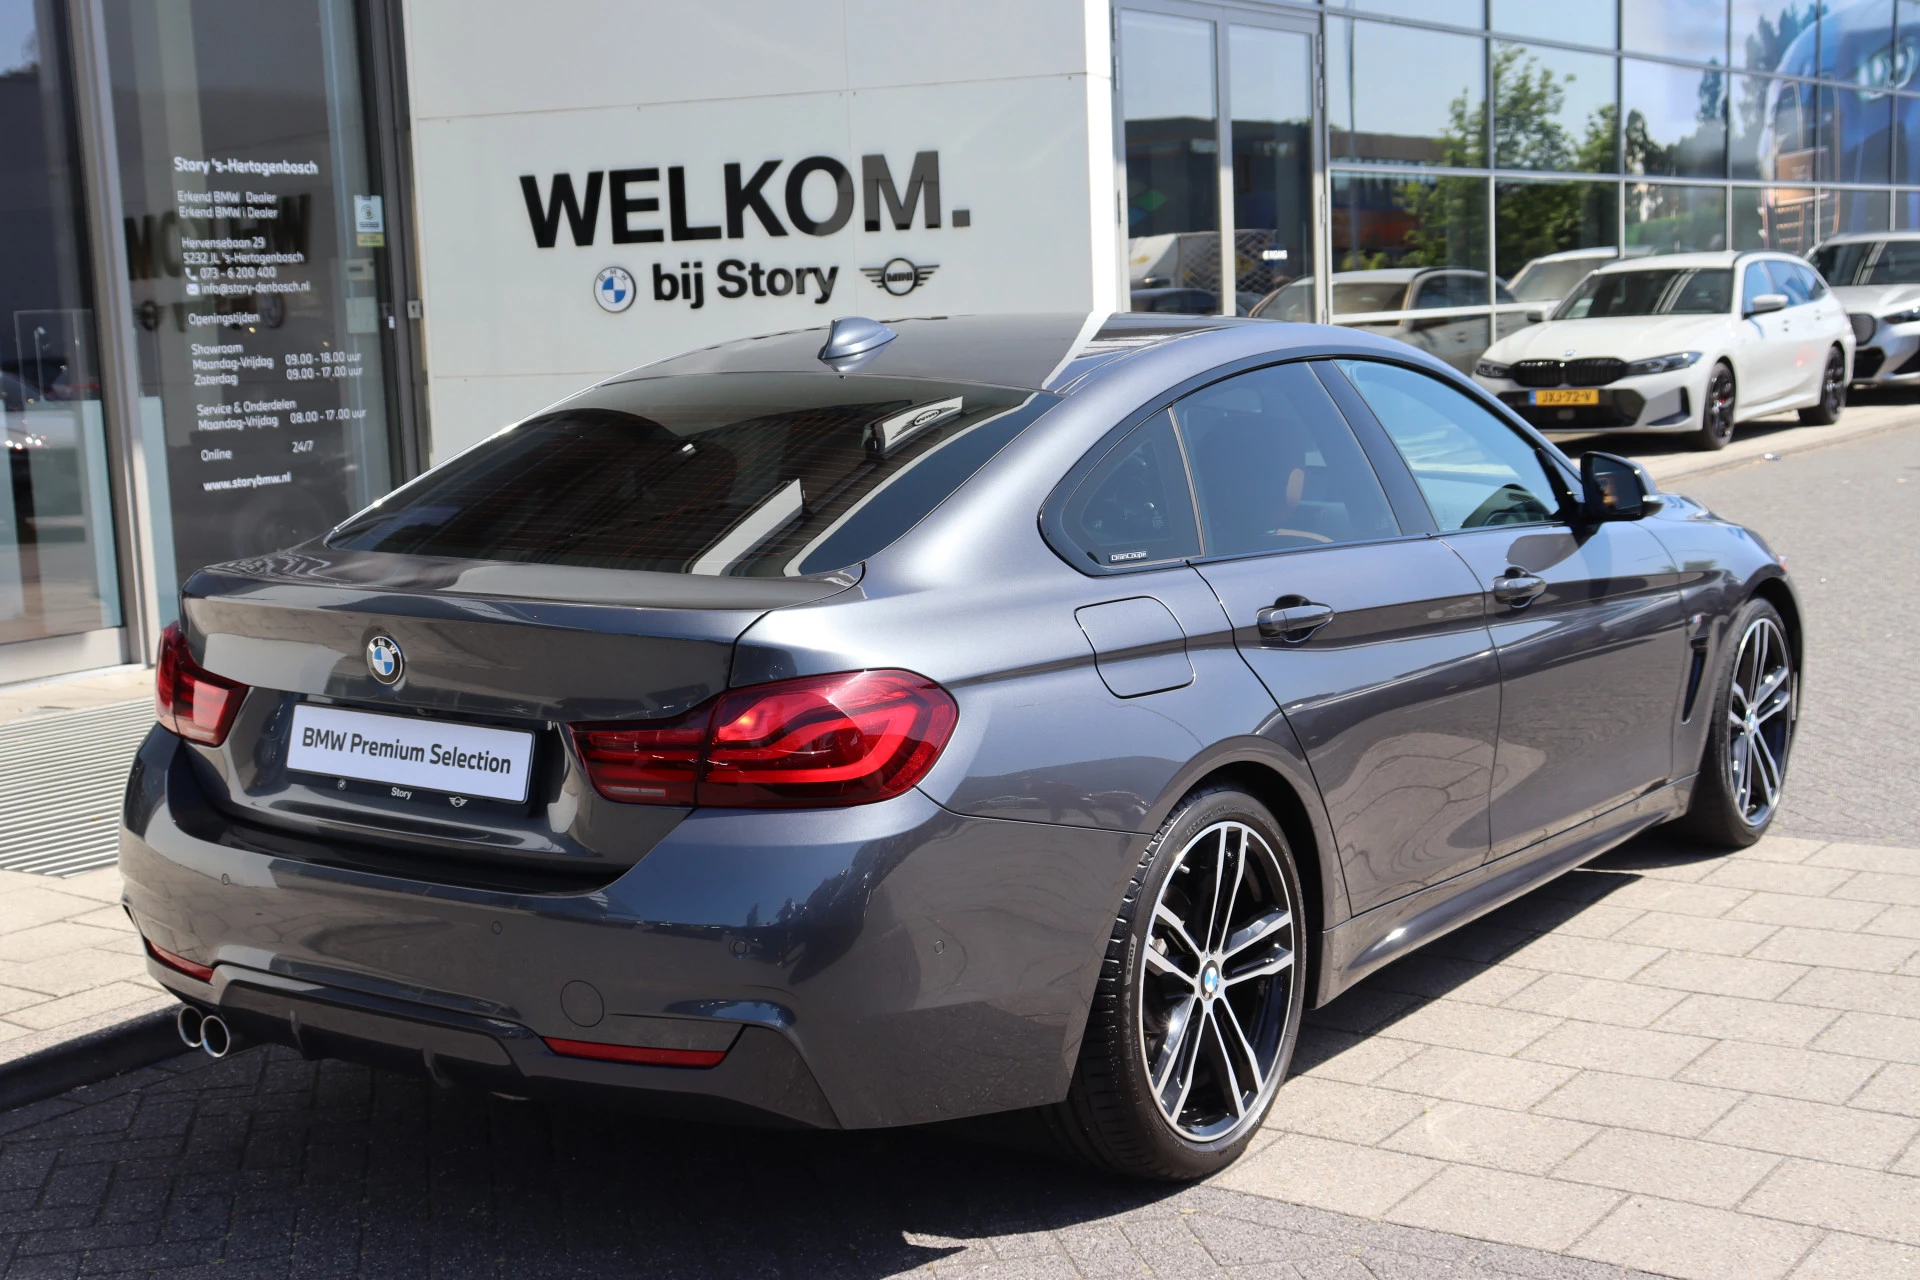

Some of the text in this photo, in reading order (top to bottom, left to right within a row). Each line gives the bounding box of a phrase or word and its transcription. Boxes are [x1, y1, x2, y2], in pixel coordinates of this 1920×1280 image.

[173, 156, 319, 177] Story 's-Hertogenbosch
[177, 190, 278, 204] Erkend BMW Dealer
[519, 150, 971, 249] WELKOM.
[178, 205, 278, 219] Erkend BMW i Dealer
[181, 236, 266, 249] Hervensebaan 29
[183, 251, 304, 265] 5232 JL 's-Hertogenbosch
[200, 266, 219, 279] 073
[227, 267, 235, 279] 6
[235, 266, 256, 279] 200
[257, 266, 277, 278] 400
[886, 271, 914, 282] MINI
[200, 280, 311, 295] info@story-denbosch.nl
[652, 258, 839, 310] bij Story
[188, 312, 261, 326] Openingstijden
[191, 343, 243, 356] Showroom
[192, 356, 274, 371] Maandag-Vrijdag
[285, 353, 313, 366] 09.00
[320, 351, 345, 363] 18.00
[346, 352, 362, 362] uur
[194, 374, 239, 387] Zaterdag
[286, 367, 314, 380] 09.00
[321, 365, 347, 378] 17.00
[348, 366, 363, 376] uur
[1542, 391, 1592, 402] JXJ-72-V
[196, 399, 297, 416] Service & Onderdelen
[198, 415, 279, 431] Maandag-Vrijdag
[290, 411, 318, 424] 08.00
[324, 409, 350, 421] 17.00
[351, 409, 367, 419] uur
[200, 440, 314, 461] Online 24/7
[203, 471, 292, 491] www.storybmw.nl
[368, 638, 398, 655] BMW
[302, 726, 512, 774] BMW Premium Selection
[391, 787, 412, 800] Story
